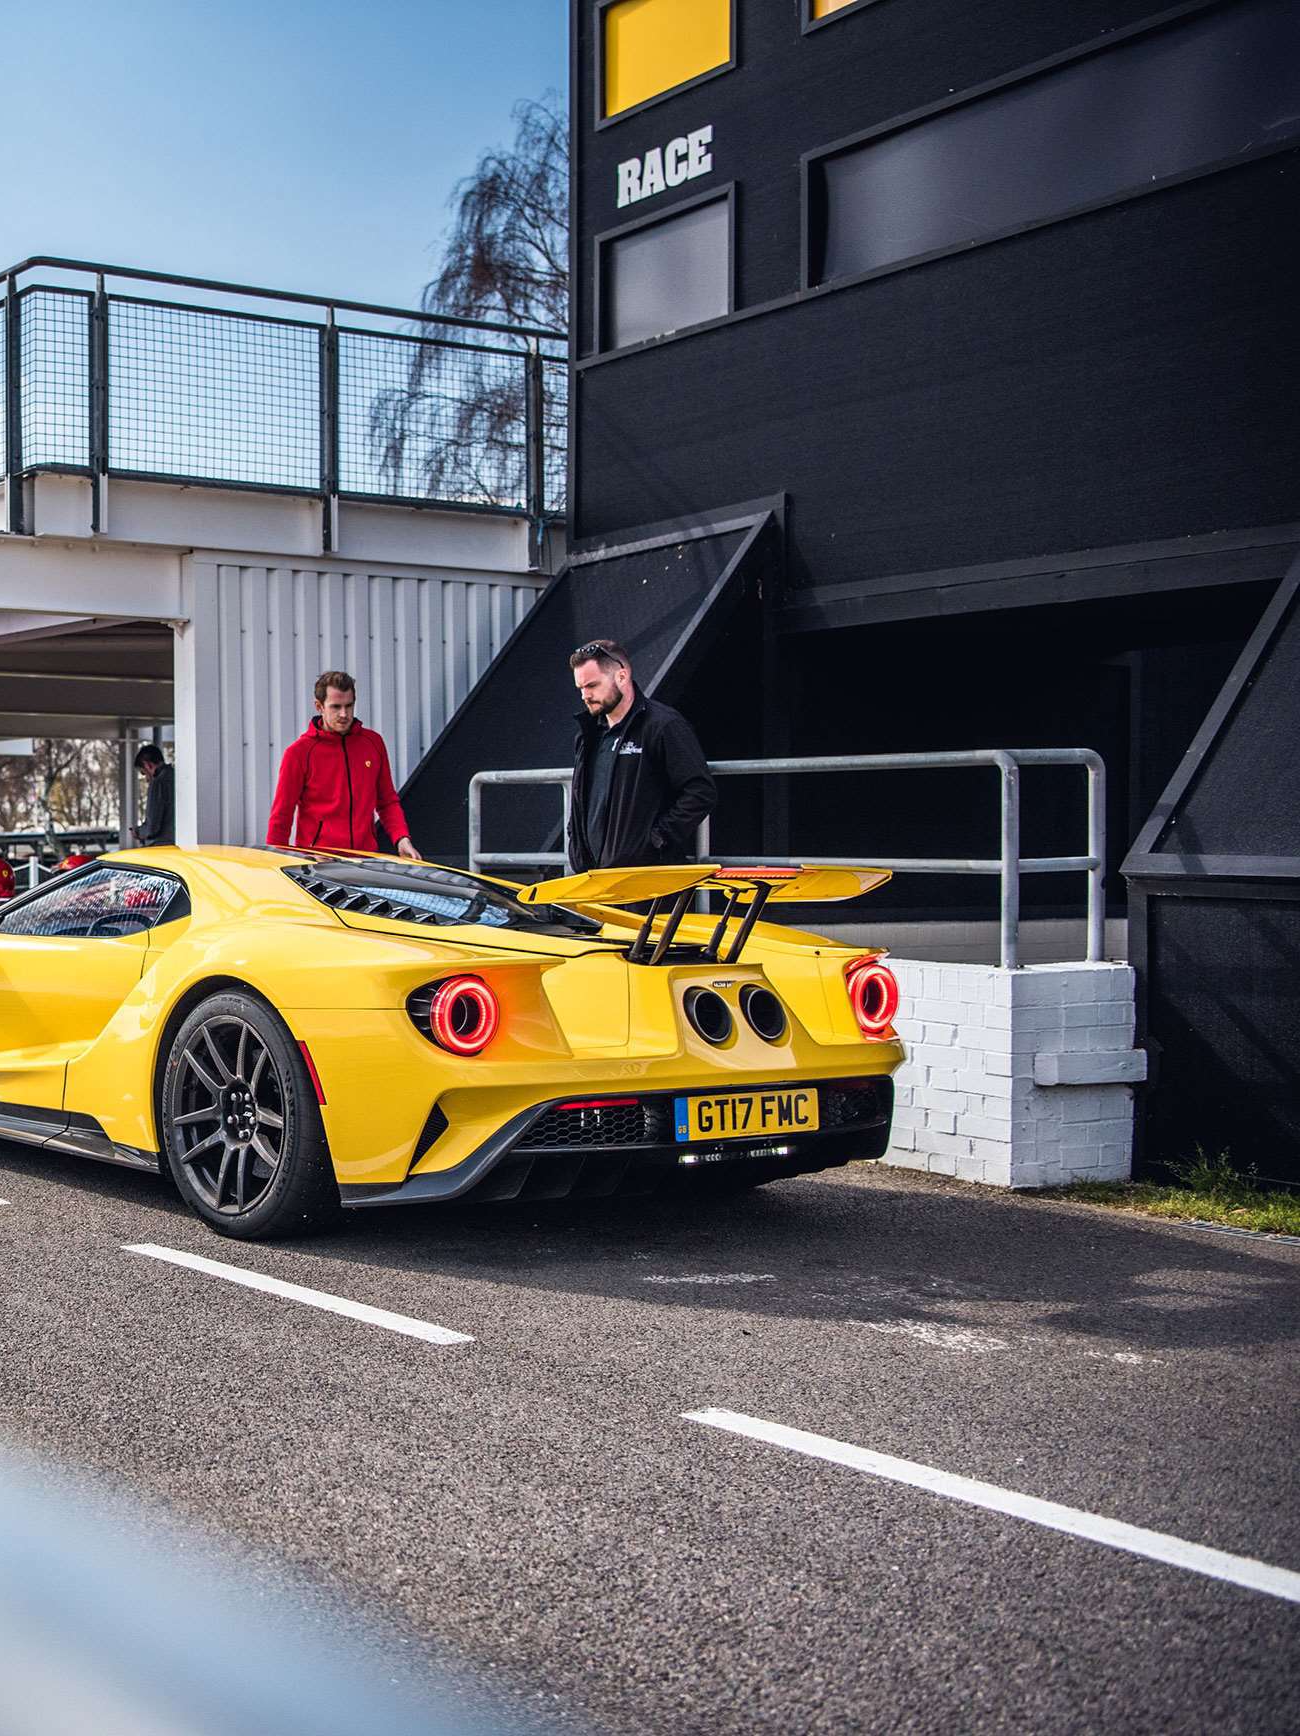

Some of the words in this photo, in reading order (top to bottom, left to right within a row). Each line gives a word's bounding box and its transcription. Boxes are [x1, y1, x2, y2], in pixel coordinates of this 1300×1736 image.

[617, 124, 713, 208] RACE
[698, 1098, 753, 1132] GT17
[761, 1094, 809, 1128] FMC
